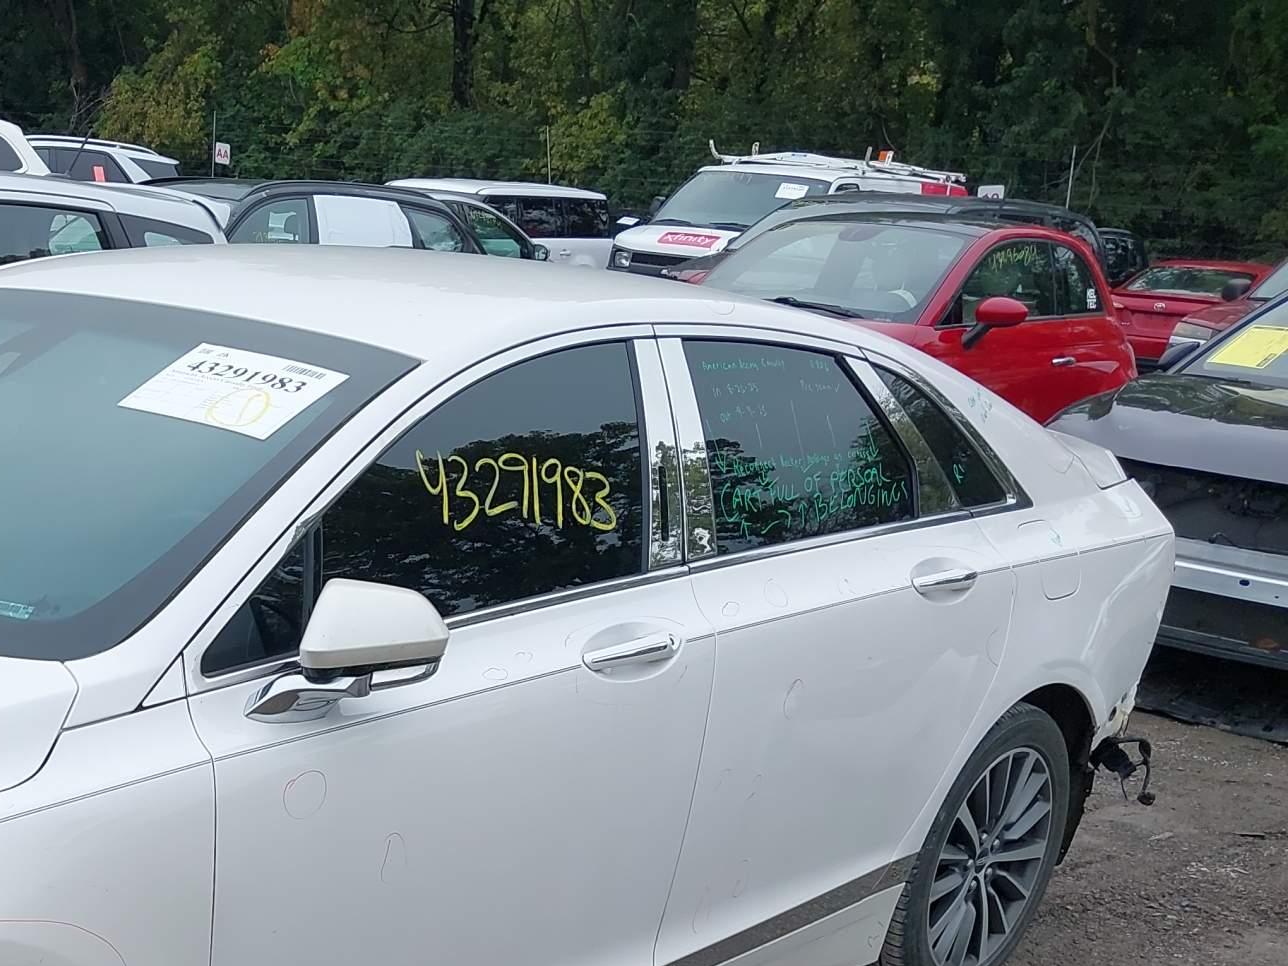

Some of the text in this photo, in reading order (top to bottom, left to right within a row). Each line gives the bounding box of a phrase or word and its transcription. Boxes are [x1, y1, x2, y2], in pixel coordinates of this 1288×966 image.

[216, 148, 229, 159] AA
[663, 234, 716, 246] xfinity
[186, 360, 308, 394] 43291983
[415, 449, 617, 532] 43291983
[804, 472, 822, 493] OF
